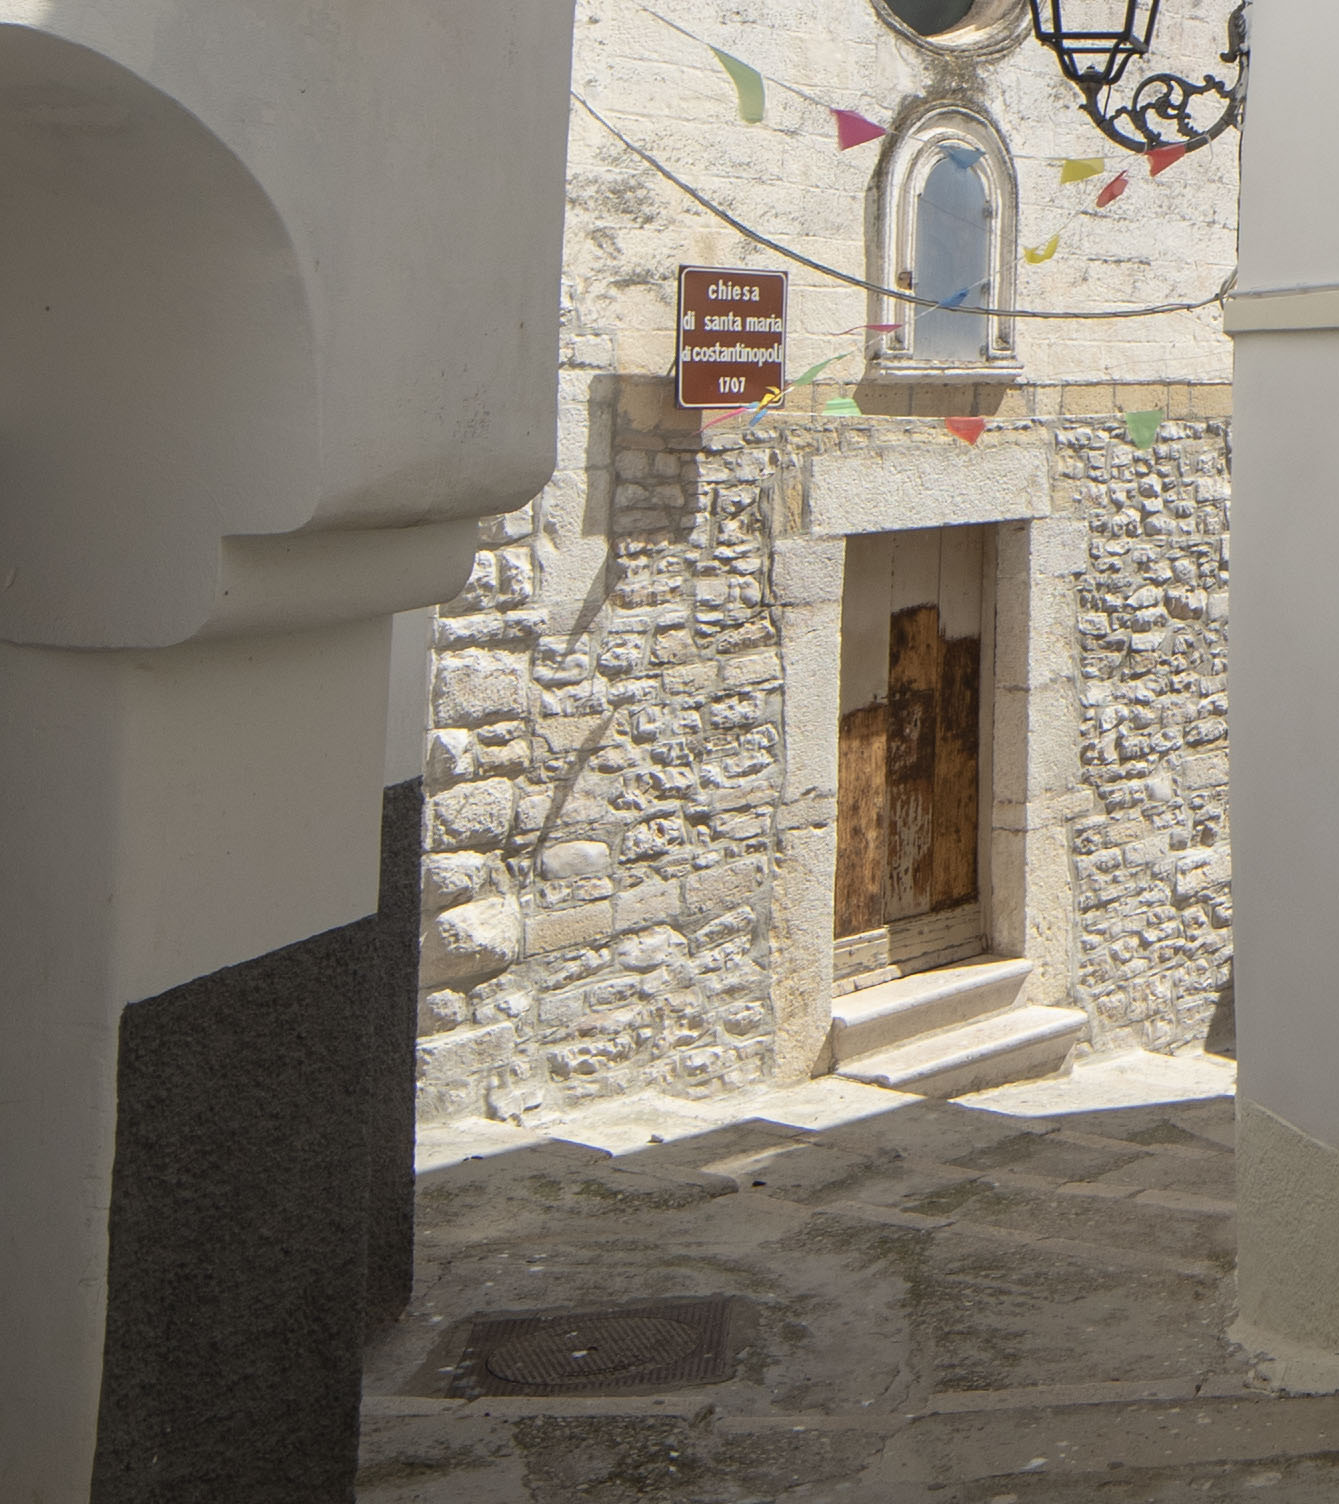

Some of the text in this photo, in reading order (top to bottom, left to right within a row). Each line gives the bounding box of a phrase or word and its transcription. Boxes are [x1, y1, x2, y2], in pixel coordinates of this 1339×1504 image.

[708, 279, 760, 302] chiesa
[683, 310, 782, 332] di santa maria
[681, 342, 784, 367] di costantinopoli
[718, 376, 746, 394] 1707
